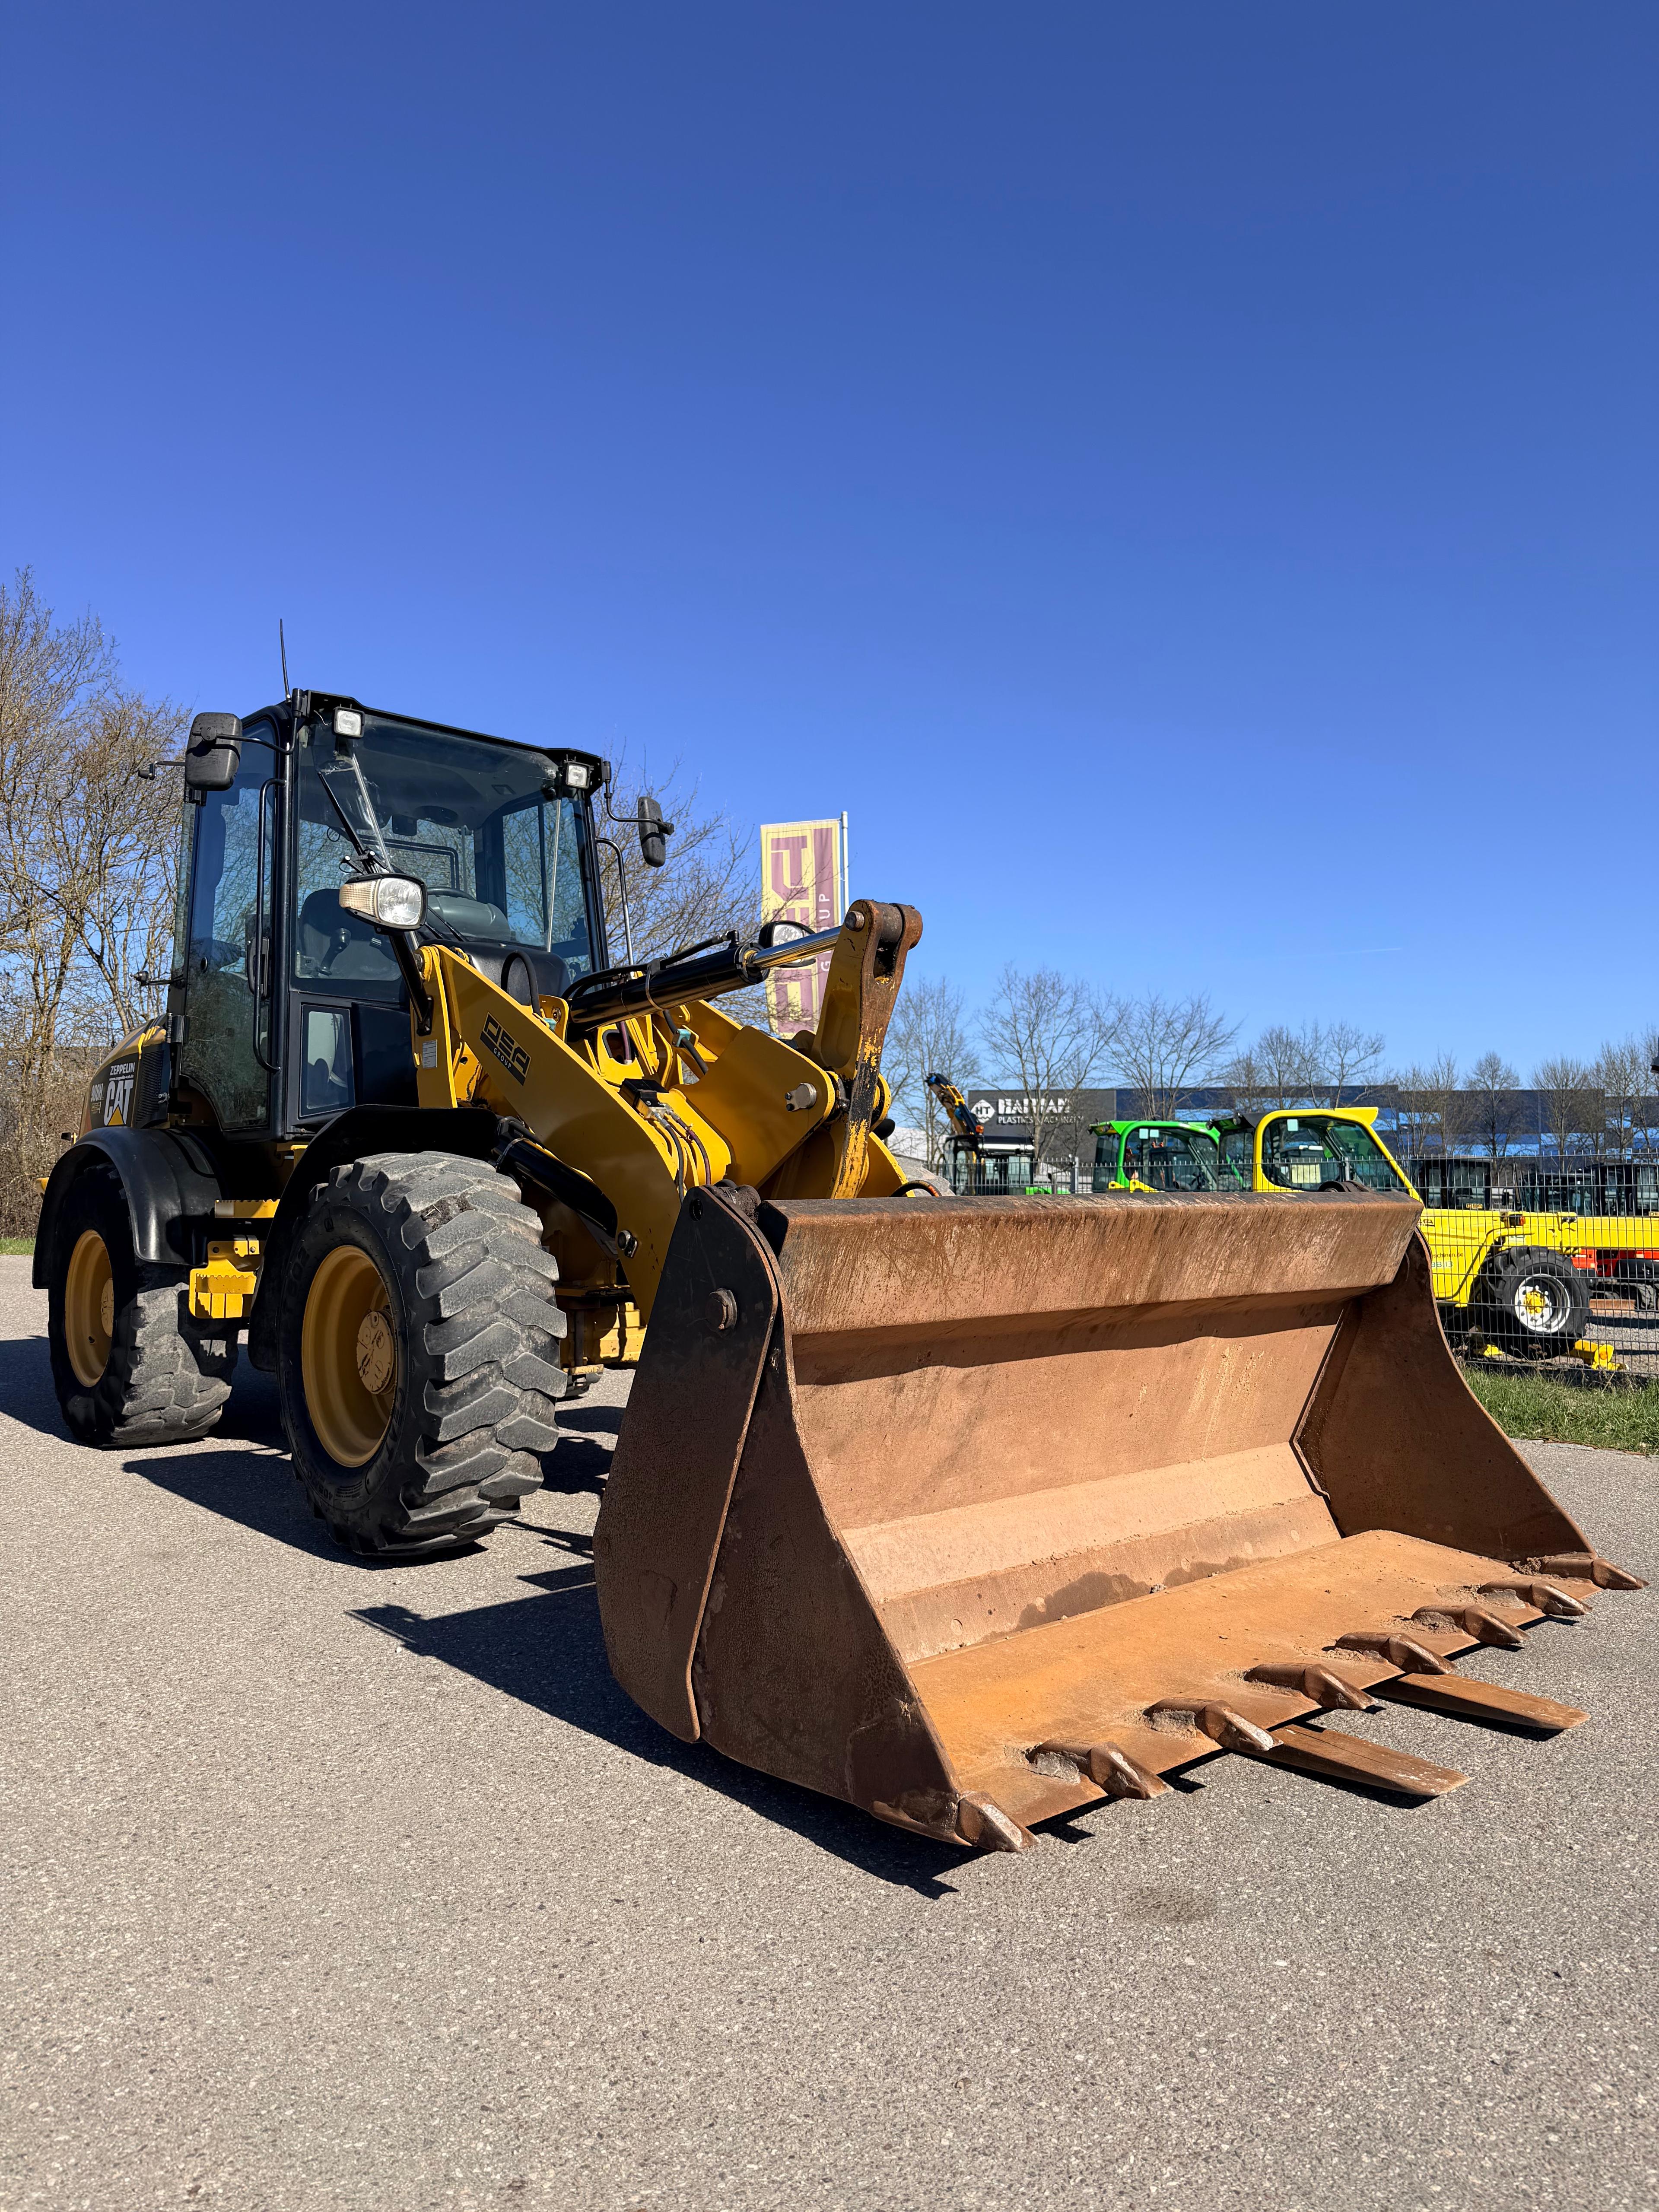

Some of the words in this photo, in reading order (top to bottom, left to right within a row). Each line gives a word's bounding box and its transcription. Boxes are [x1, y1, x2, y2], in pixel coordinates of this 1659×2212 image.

[484, 1014, 531, 1075] DEA
[493, 1048, 512, 1068] GROUP
[110, 1062, 135, 1075] ZEPPELIN
[104, 1080, 134, 1125] CAT
